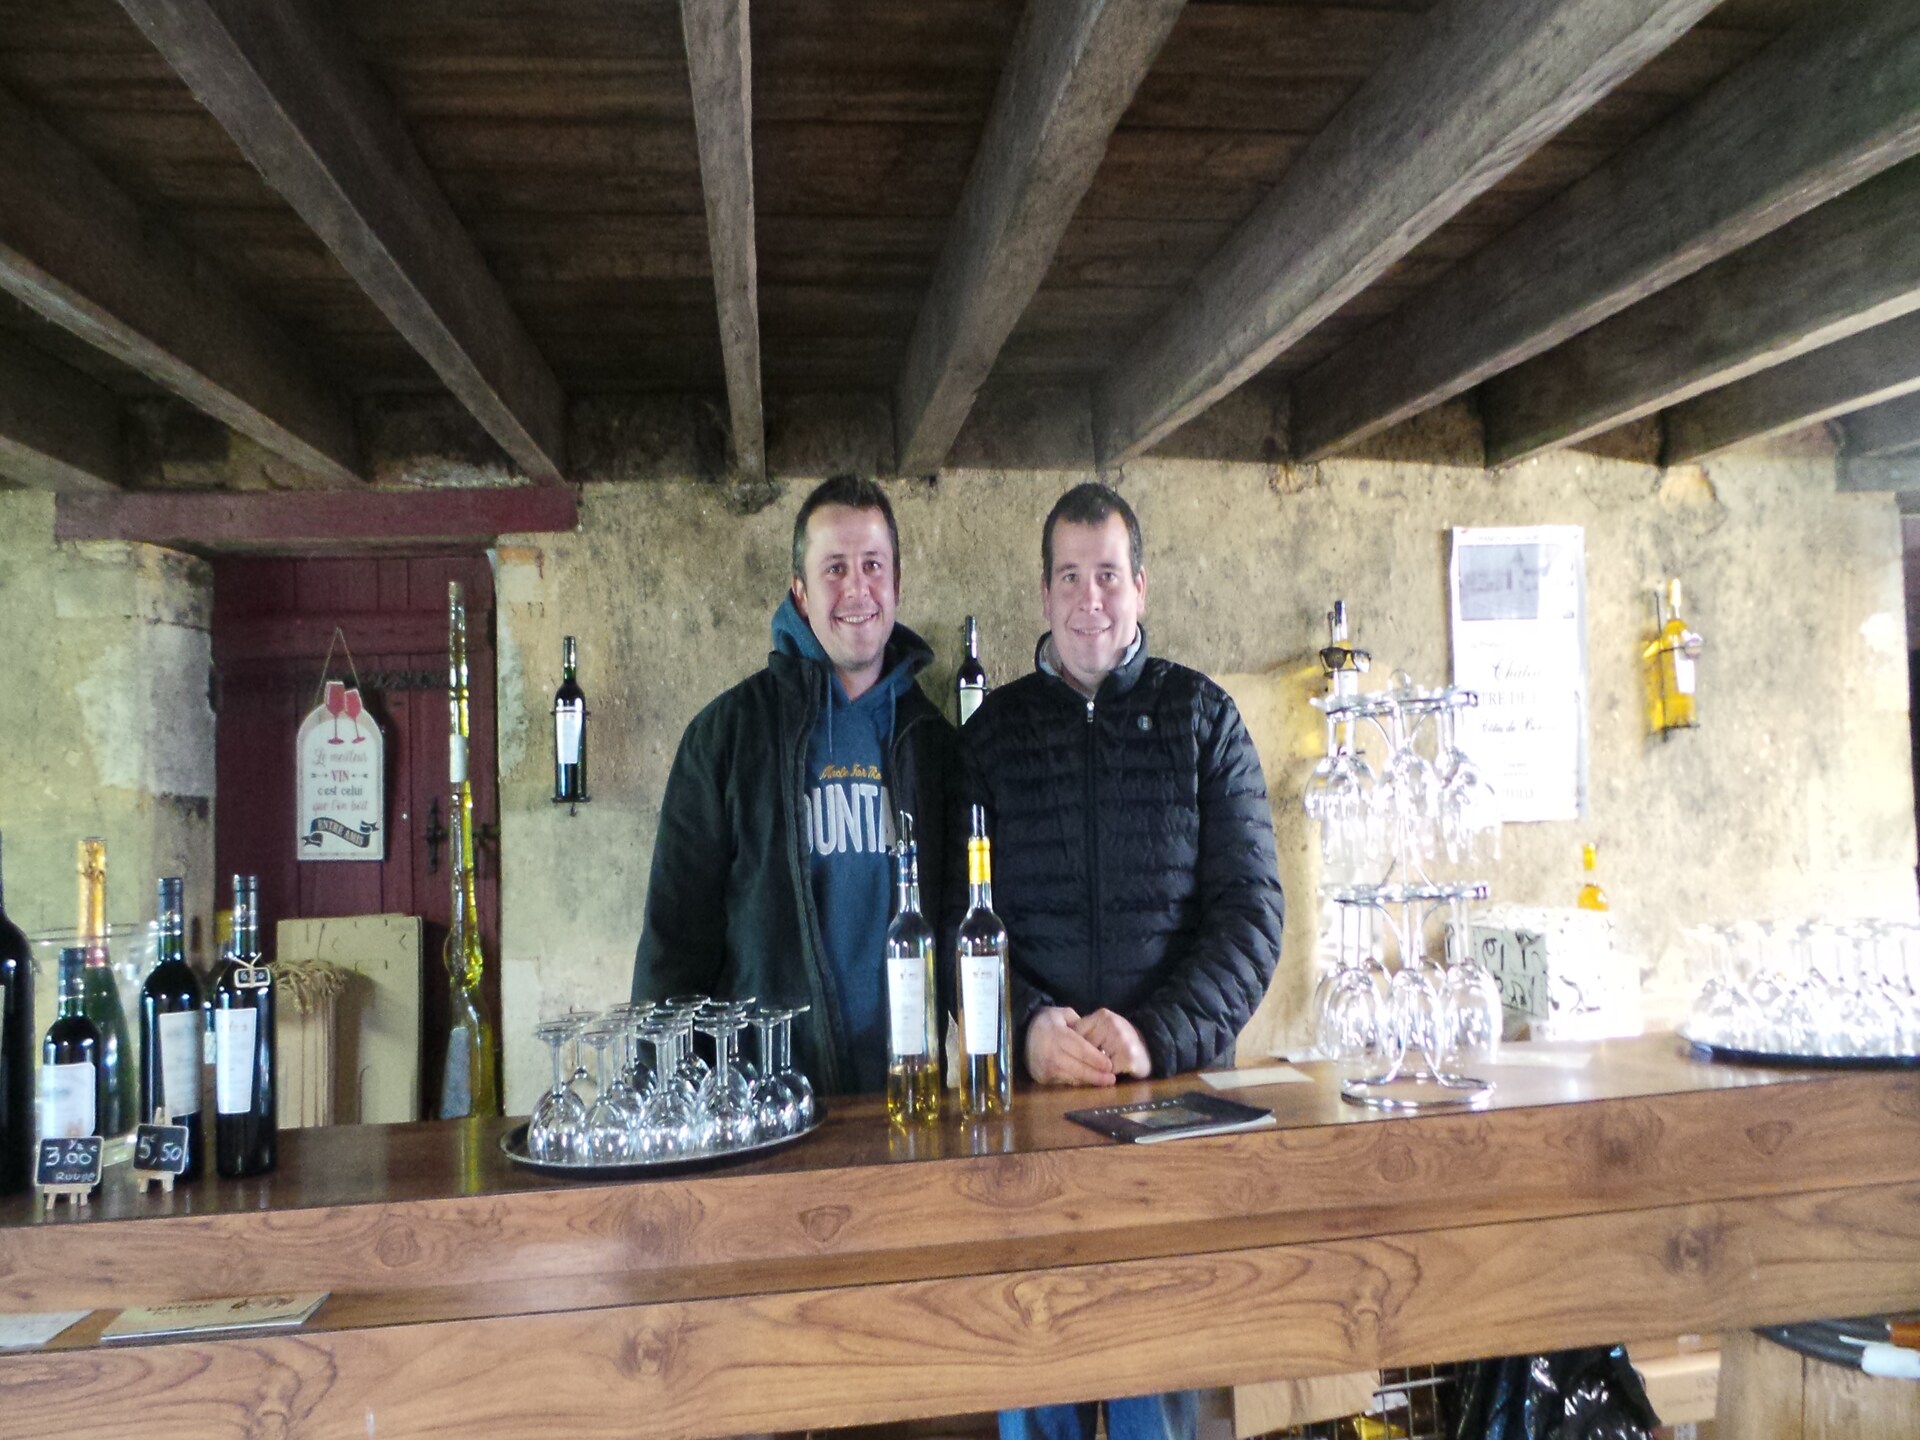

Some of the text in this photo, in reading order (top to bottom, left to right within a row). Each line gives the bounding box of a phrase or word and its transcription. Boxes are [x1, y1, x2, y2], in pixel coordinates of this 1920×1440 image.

[331, 769, 350, 782] VIN
[819, 764, 848, 780] Made
[850, 763, 867, 777] For
[341, 785, 363, 796] celui
[317, 820, 365, 847] ENTRE AMIS
